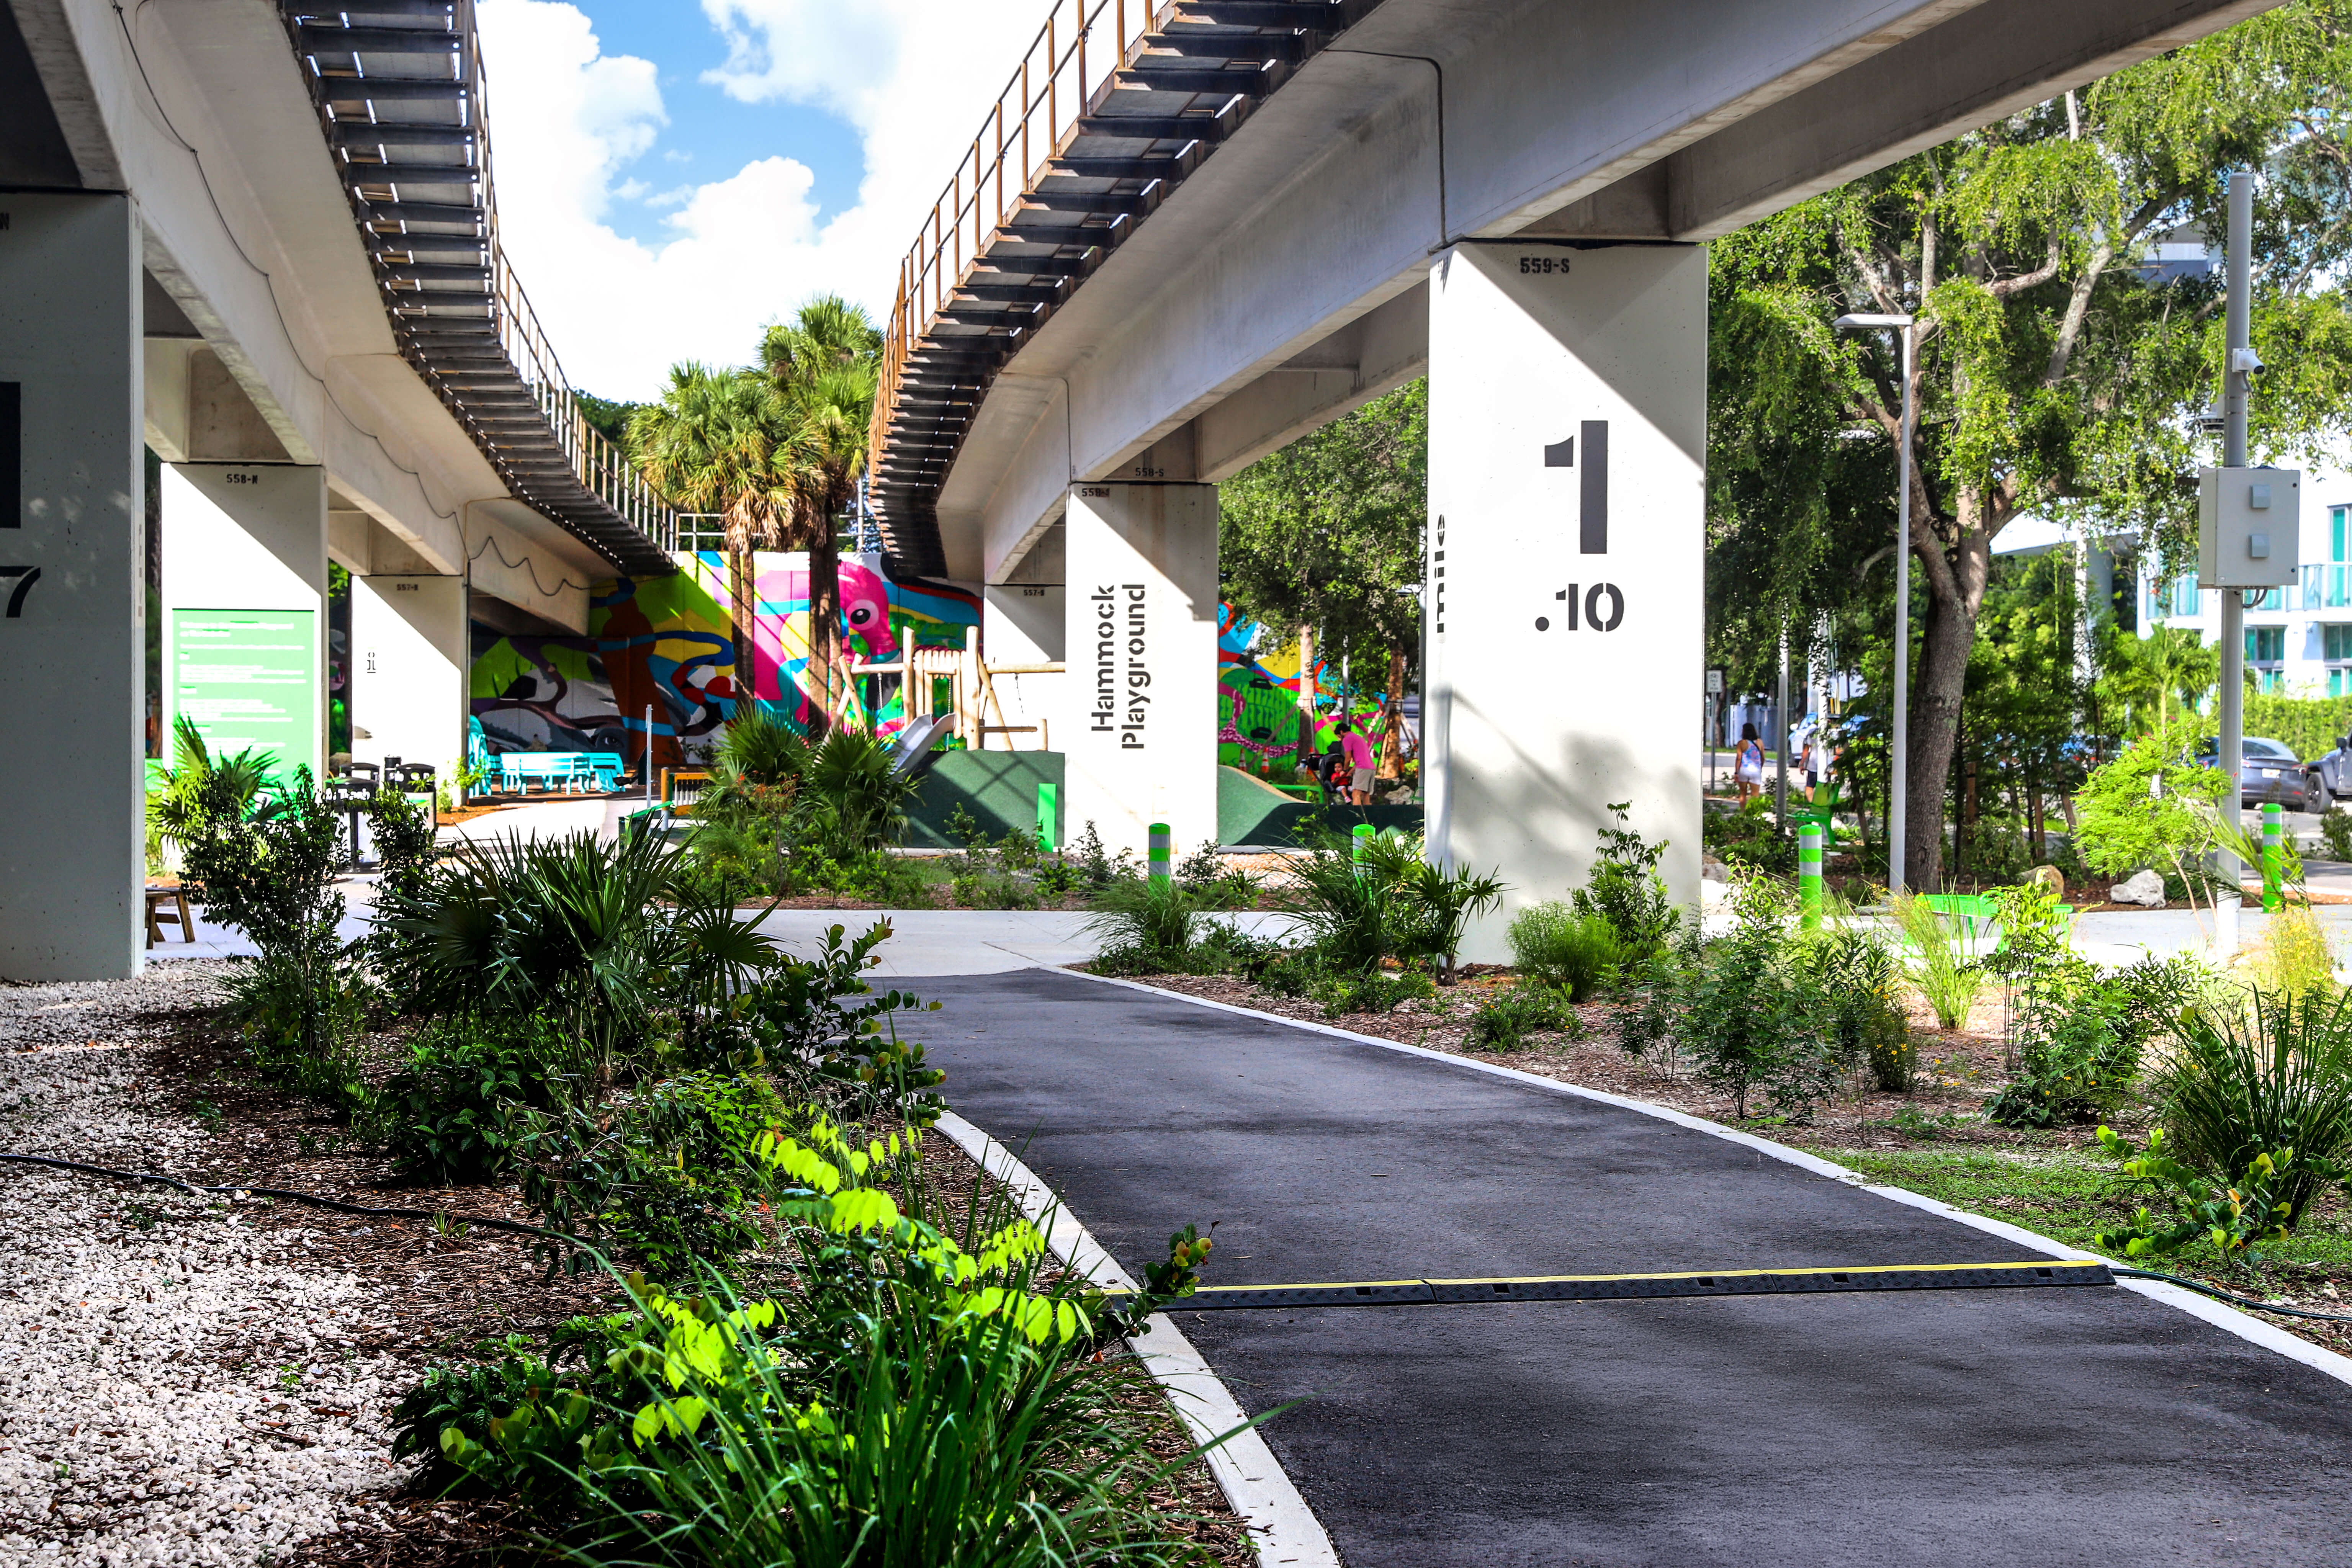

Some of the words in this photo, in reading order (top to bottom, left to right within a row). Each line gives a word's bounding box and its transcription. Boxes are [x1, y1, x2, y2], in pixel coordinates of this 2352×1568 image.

[1520, 258, 1570, 273] 559-S
[227, 474, 258, 484] 558-N
[1135, 467, 1164, 477] 558-S
[1545, 420, 1608, 554] 1
[1535, 583, 1624, 632] .10
[1091, 584, 1114, 731] Hammock
[1121, 584, 1151, 749] Playground
